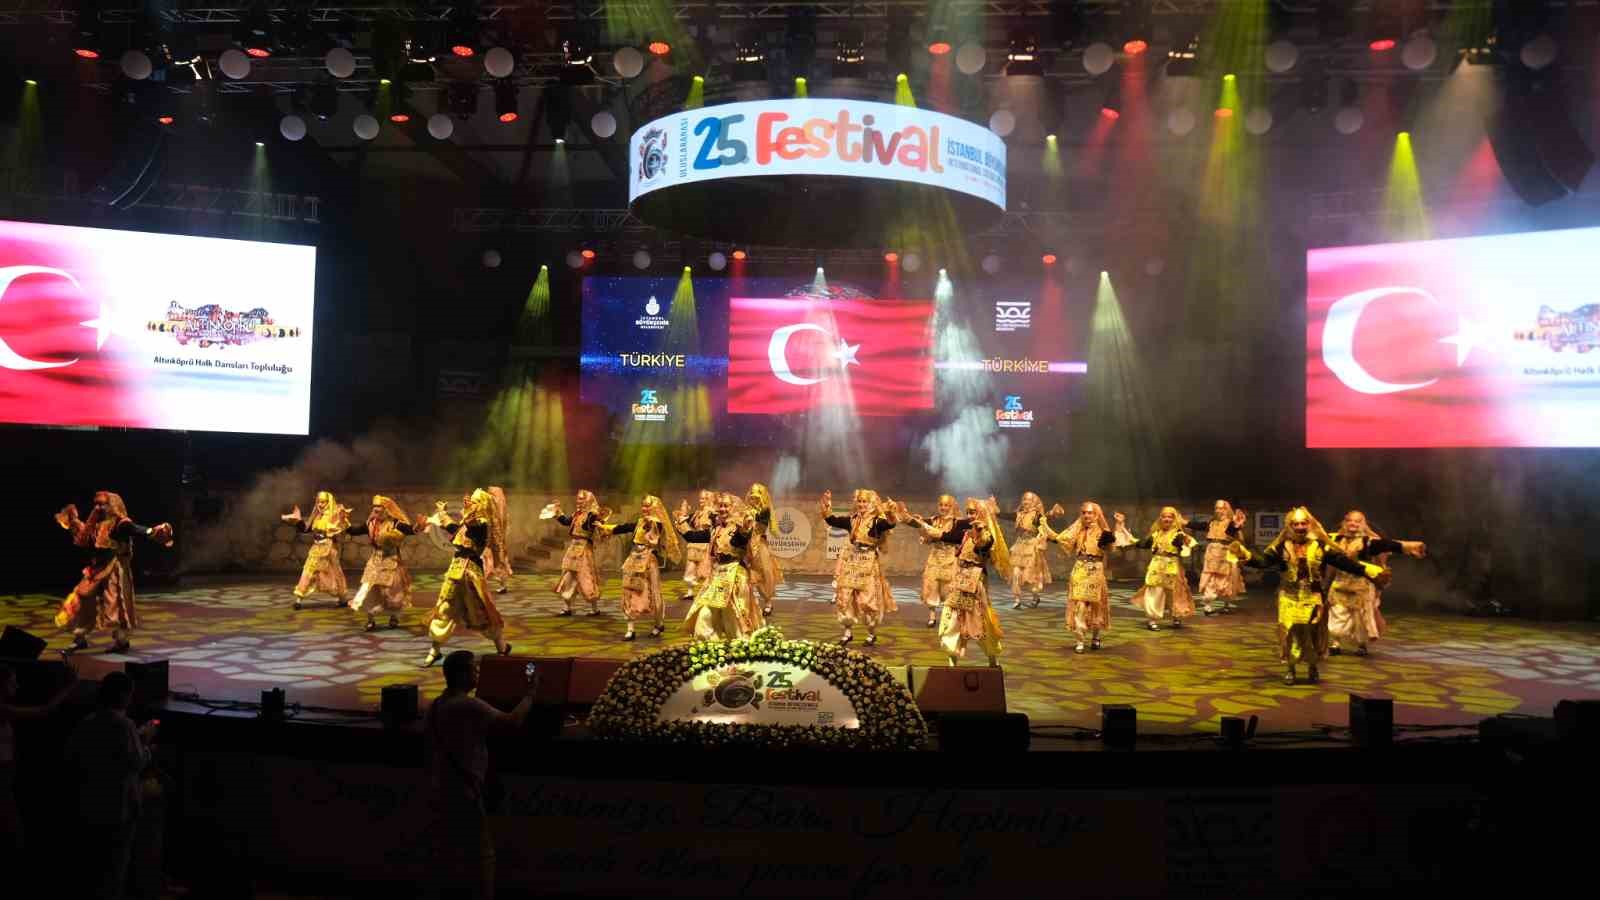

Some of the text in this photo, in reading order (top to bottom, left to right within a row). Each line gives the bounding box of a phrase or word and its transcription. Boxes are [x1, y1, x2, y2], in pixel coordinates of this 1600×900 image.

[680, 118, 689, 178] ULUSLARARASI
[756, 109, 945, 174] Festival
[195, 358, 213, 368] Halk
[619, 351, 686, 367] TÜRKİYE
[981, 356, 1049, 373] TÜRKİYE
